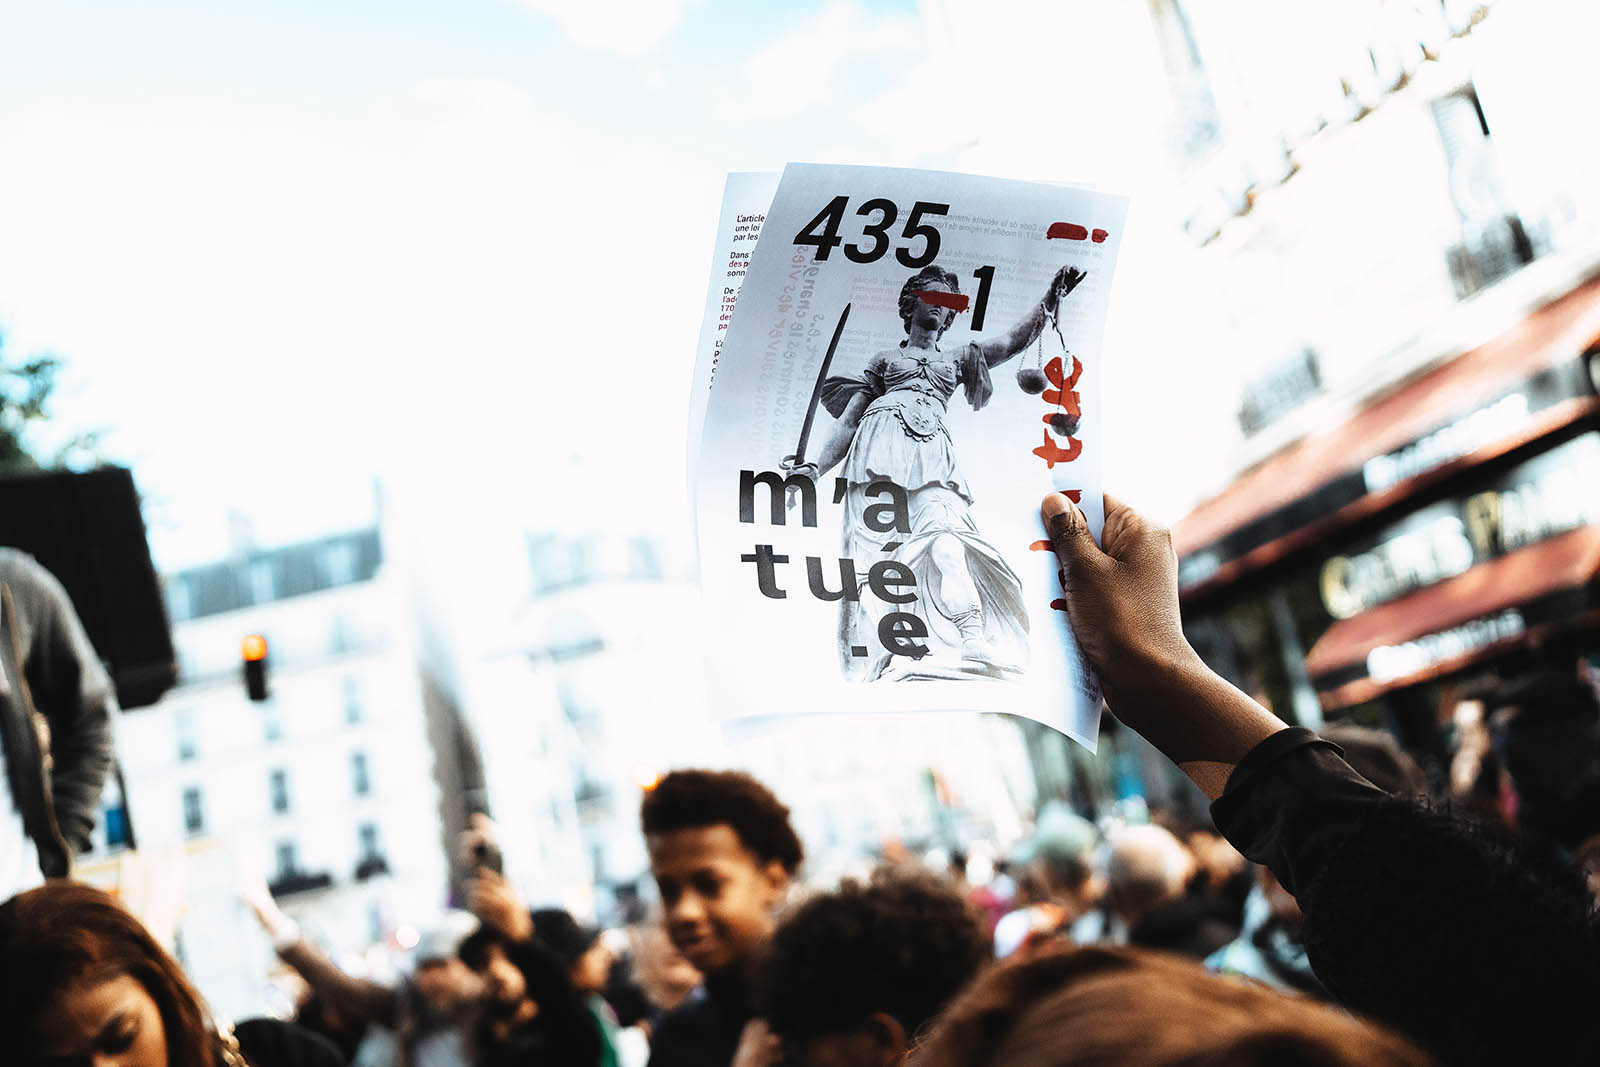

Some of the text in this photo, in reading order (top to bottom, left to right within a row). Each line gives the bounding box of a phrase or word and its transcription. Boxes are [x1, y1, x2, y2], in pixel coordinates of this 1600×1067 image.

[736, 214, 766, 223] L'article
[750, 223, 761, 231] loi
[793, 196, 951, 269] 435
[733, 233, 759, 242] par les
[730, 251, 750, 259] Dans
[728, 260, 742, 268] des
[723, 287, 735, 295] De
[970, 265, 996, 332] 1
[1032, 354, 1084, 470] tue
[738, 469, 913, 535] m'a
[740, 542, 920, 605] tué
